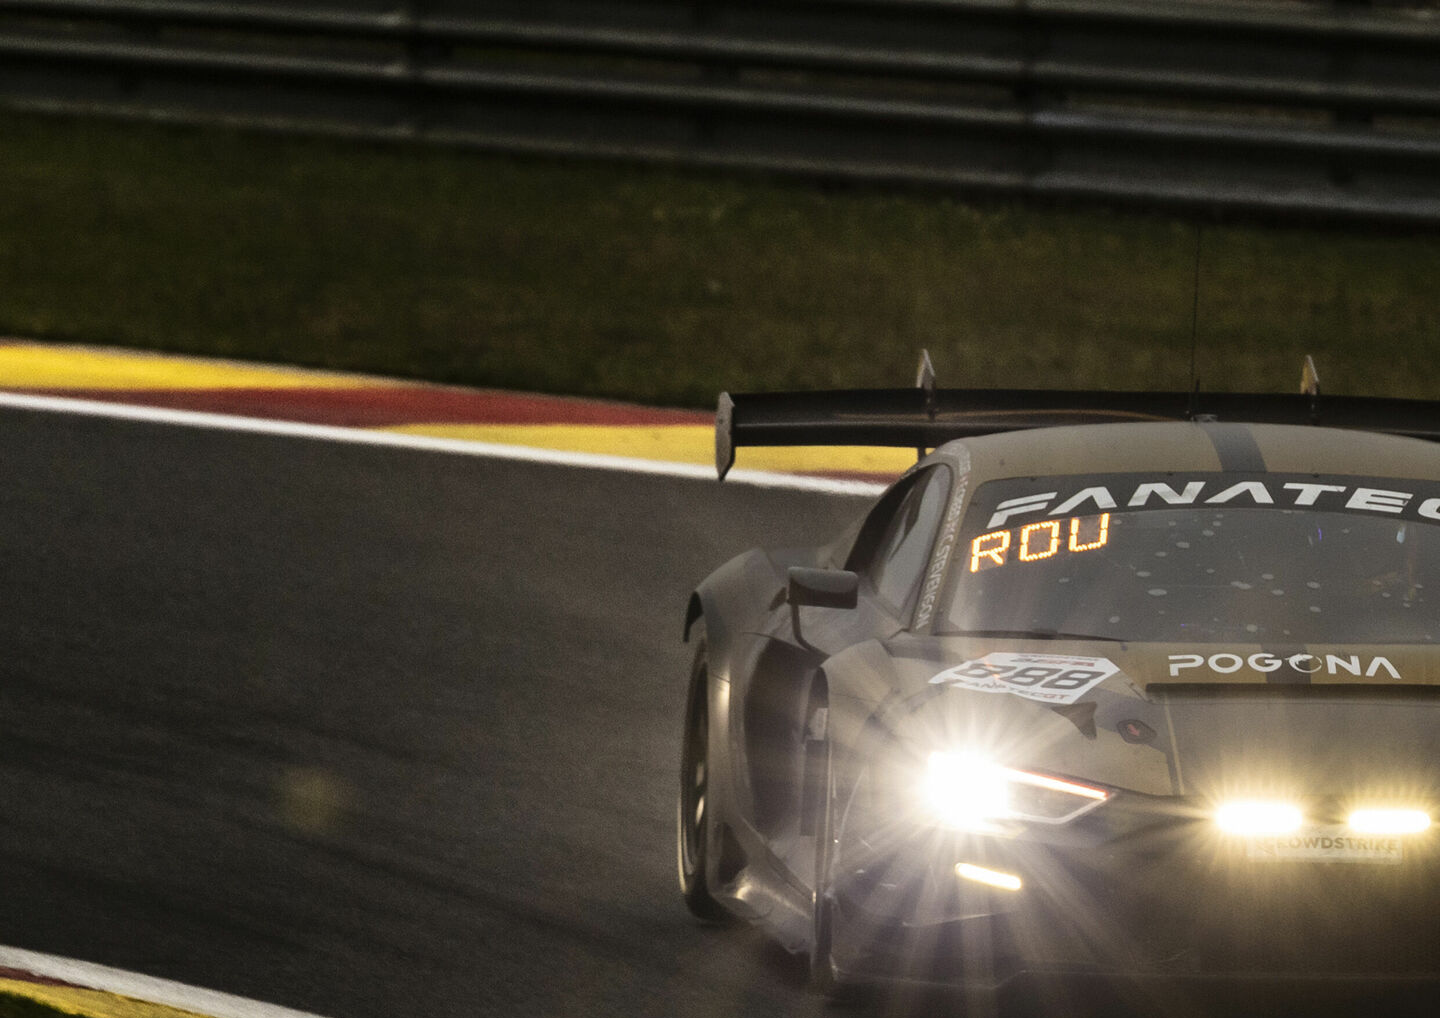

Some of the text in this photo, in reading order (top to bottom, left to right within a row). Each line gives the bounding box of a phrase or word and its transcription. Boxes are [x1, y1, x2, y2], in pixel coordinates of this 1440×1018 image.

[970, 512, 1110, 573] ROU
[1168, 652, 1402, 680] POGONA
[1266, 836, 1400, 852] ROWDSTRIKE
